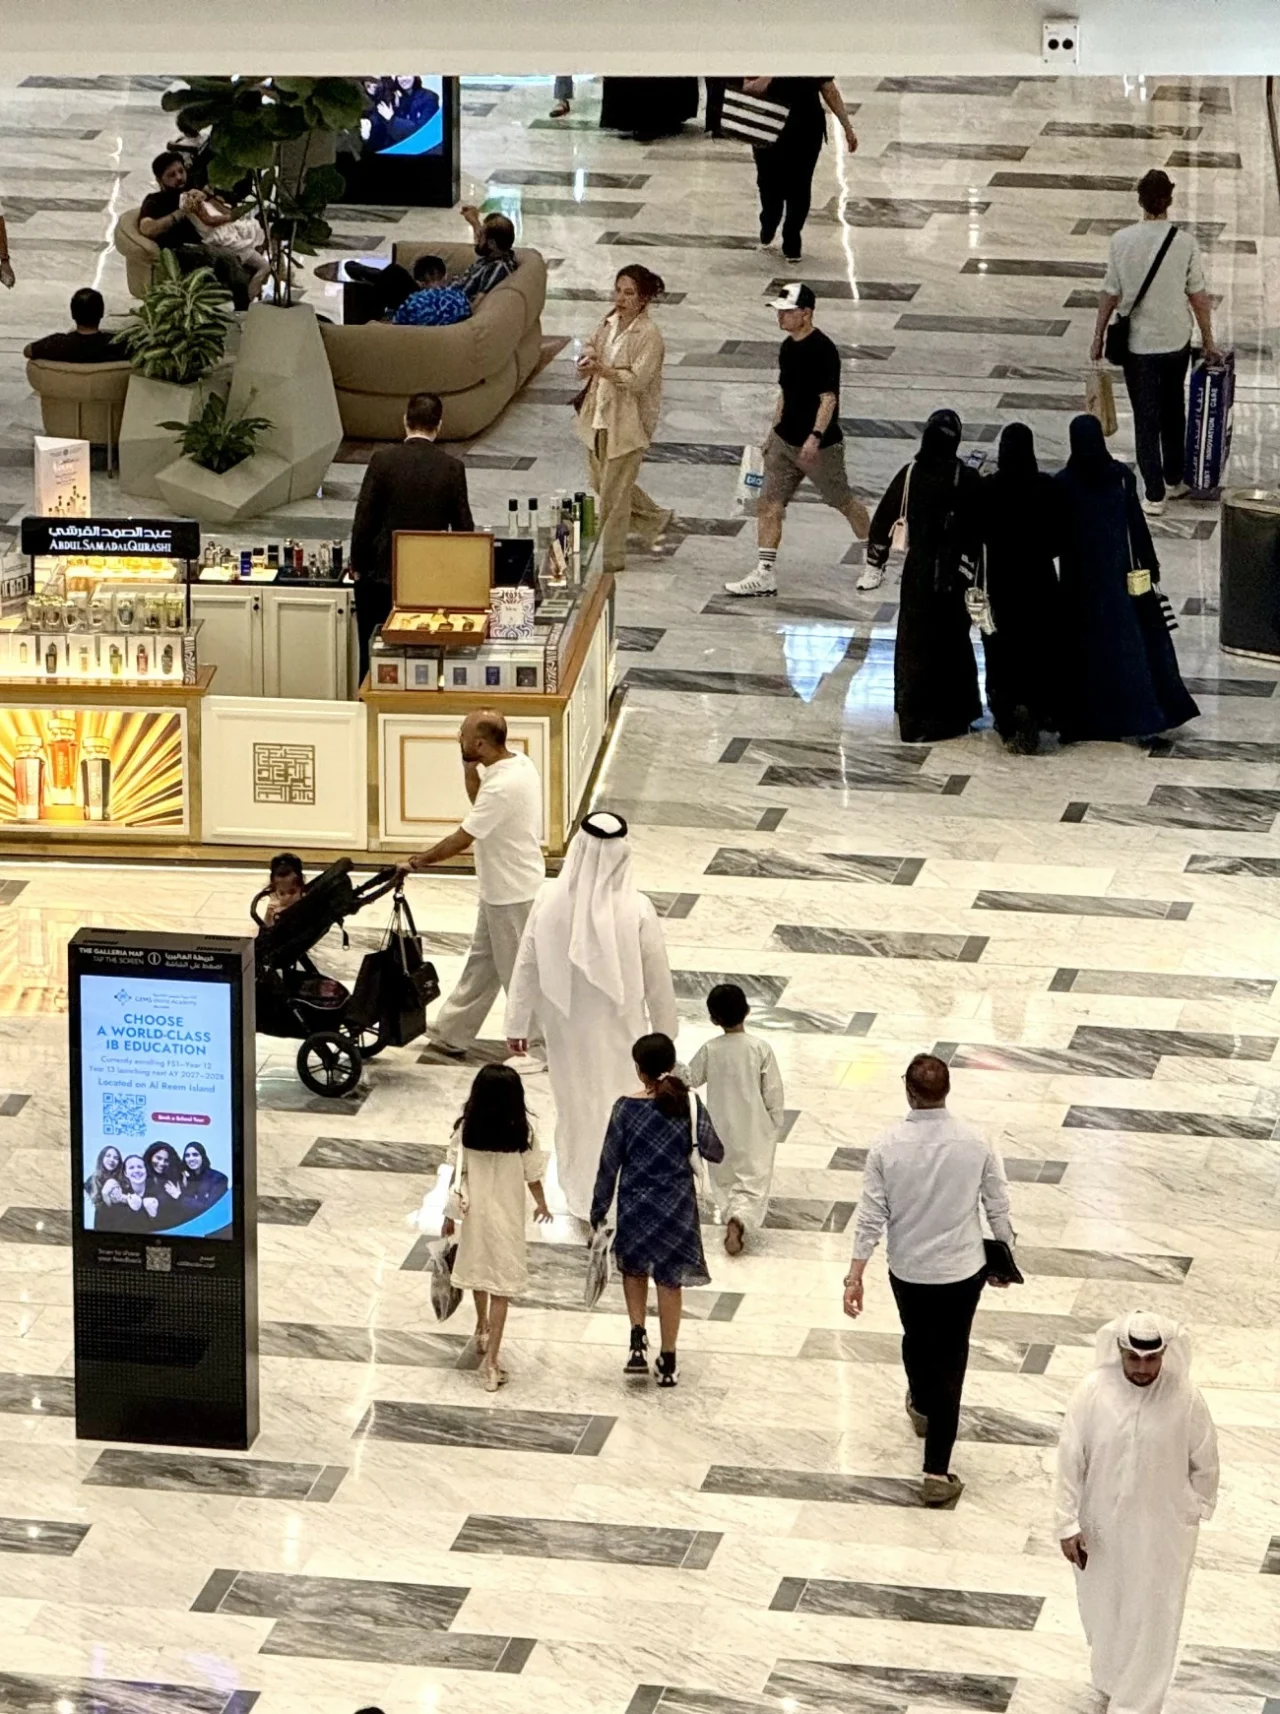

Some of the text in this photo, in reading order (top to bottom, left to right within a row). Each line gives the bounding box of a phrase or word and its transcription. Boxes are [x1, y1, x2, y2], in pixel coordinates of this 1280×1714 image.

[49, 539, 83, 550] ABDUL
[82, 539, 120, 551] SAMAD
[127, 540, 172, 553] QURASHI
[93, 948, 128, 956] GALLERIA
[119, 957, 145, 965] SCREEN
[123, 1013, 184, 1027] CHOOSE
[97, 1026, 212, 1043] A WORLD-CLASS
[106, 1039, 207, 1056] IB EDUCATION
[97, 1078, 216, 1093] Located on Al Reem Island
